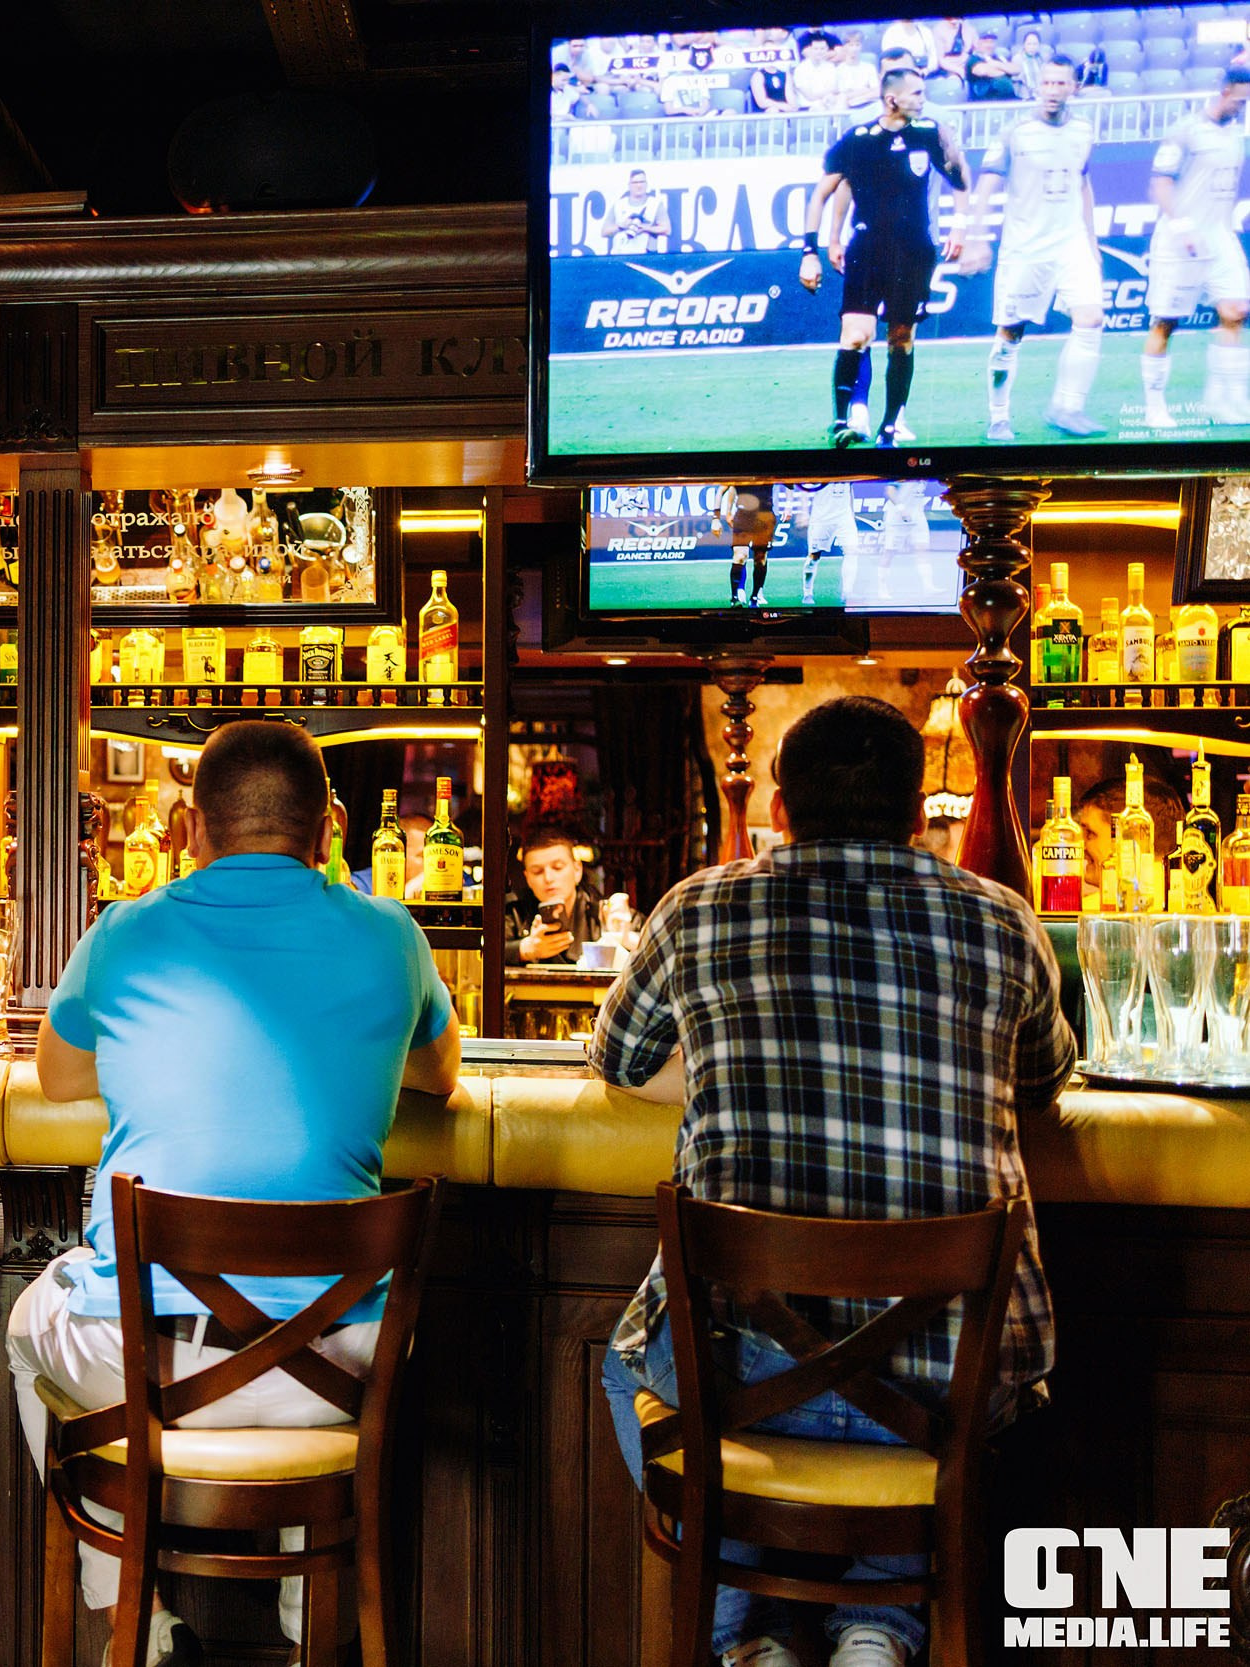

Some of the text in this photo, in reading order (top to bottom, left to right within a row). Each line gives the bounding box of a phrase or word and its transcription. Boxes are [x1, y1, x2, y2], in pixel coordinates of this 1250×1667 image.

[585, 294, 770, 329] RECORD
[603, 328, 745, 348] DANCE RADIO
[115, 328, 387, 388] ПИВНОЙ
[607, 536, 698, 552] RECORD
[616, 551, 686, 561] DANCE RADIO
